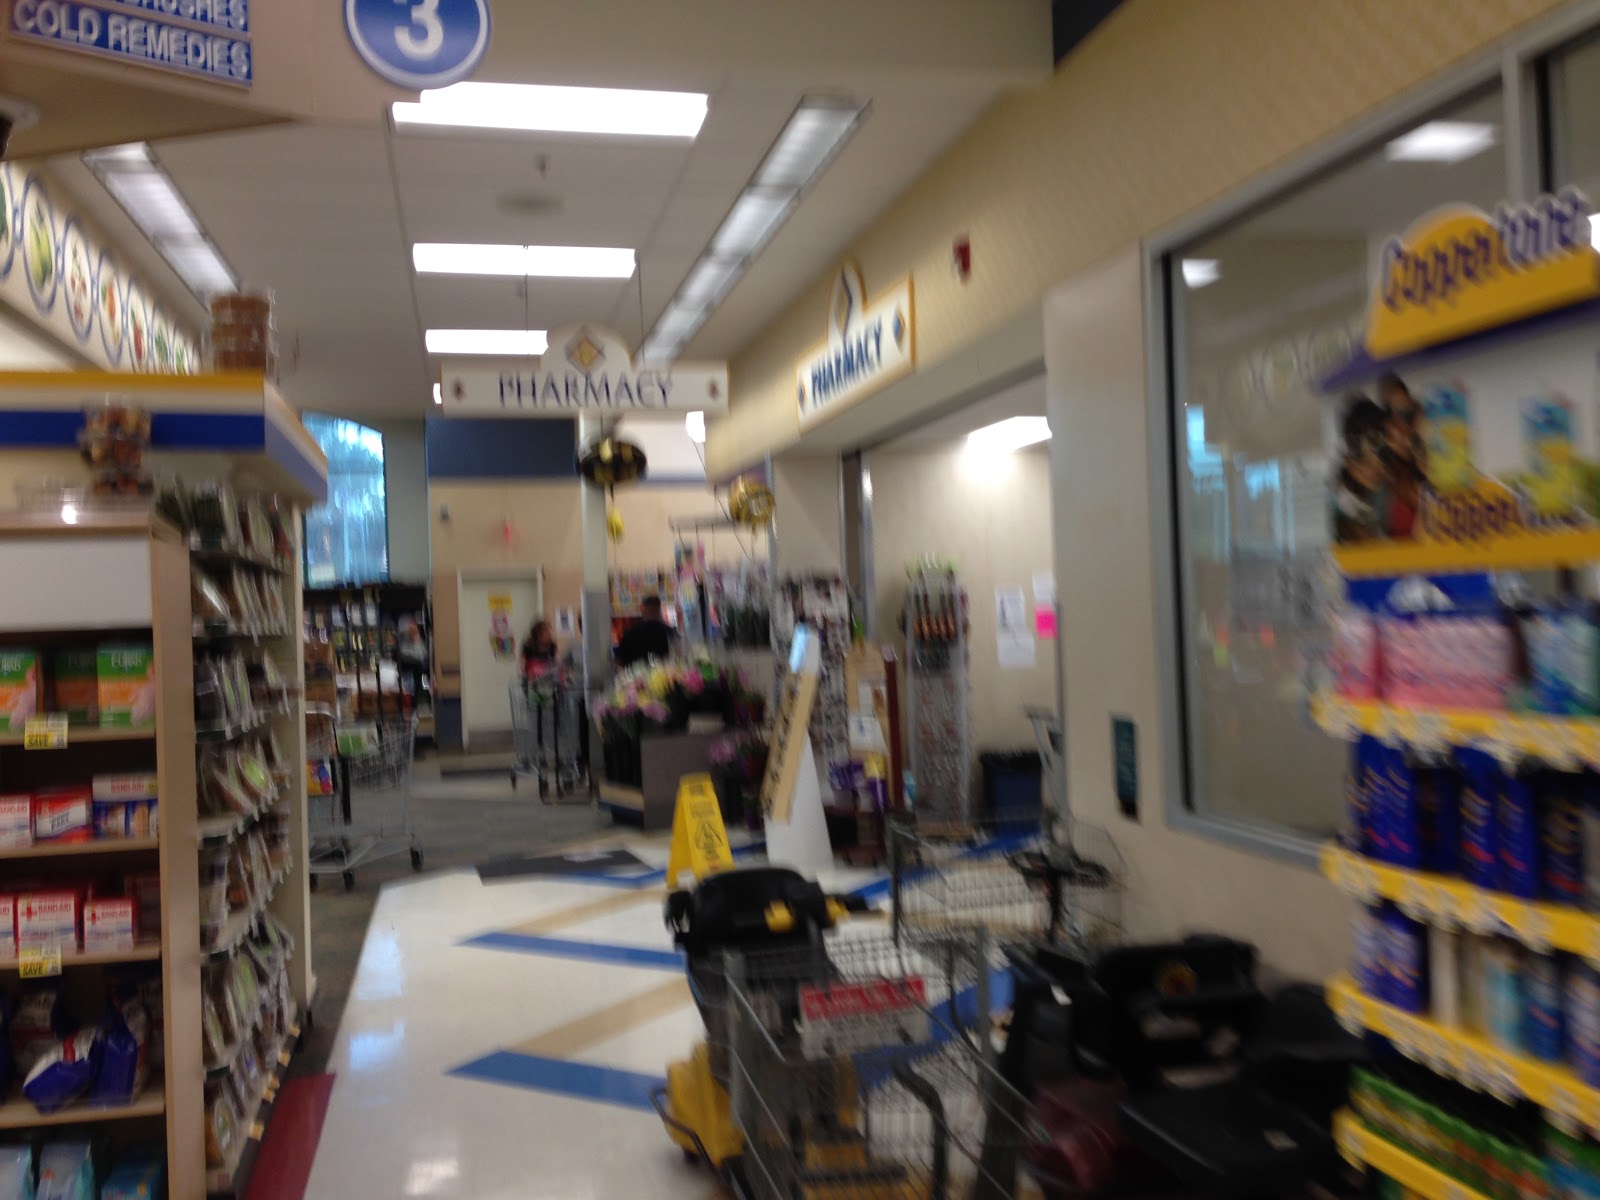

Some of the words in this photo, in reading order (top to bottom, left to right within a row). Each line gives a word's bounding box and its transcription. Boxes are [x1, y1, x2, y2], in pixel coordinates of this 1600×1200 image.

[14, 0, 99, 45] COLD
[108, 13, 249, 80] REMEDIES
[393, 0, 444, 60] 3
[498, 372, 672, 408] PHARMACY
[810, 318, 883, 407] PHARMACY
[23, 966, 43, 976] SAVE
